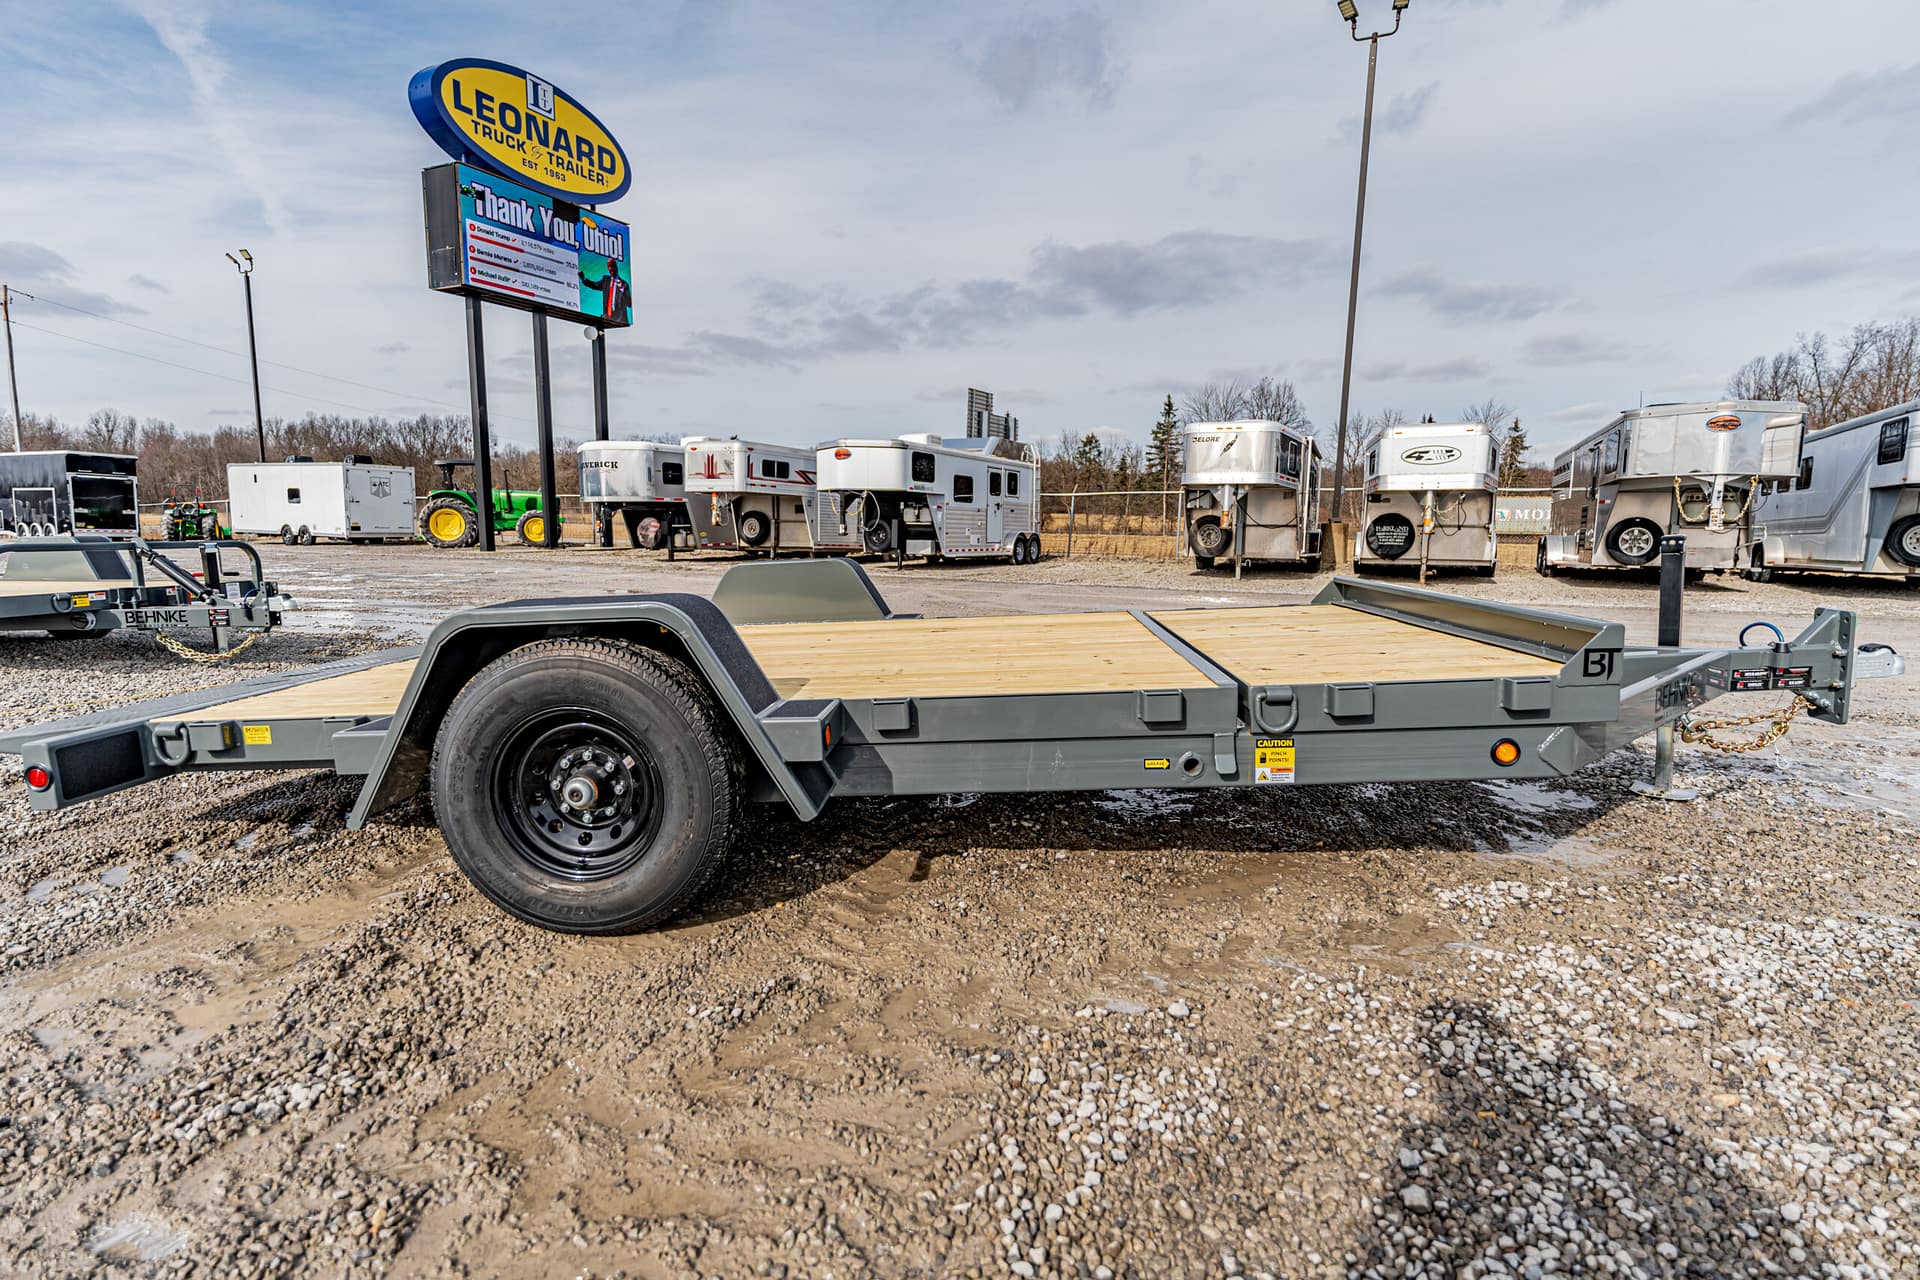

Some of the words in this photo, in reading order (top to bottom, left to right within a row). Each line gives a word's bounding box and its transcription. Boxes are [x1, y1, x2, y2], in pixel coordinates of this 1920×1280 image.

[452, 78, 616, 175] LEONARD
[471, 119, 528, 154] TRUCK
[546, 151, 605, 186] TRAILER
[522, 158, 538, 171] EST
[544, 167, 566, 182] 1963
[471, 181, 535, 233] Thank
[538, 206, 580, 250] You,
[495, 231, 511, 242] Trump
[125, 609, 189, 624] BEHNKE
[1257, 739, 1293, 747] CAUTION
